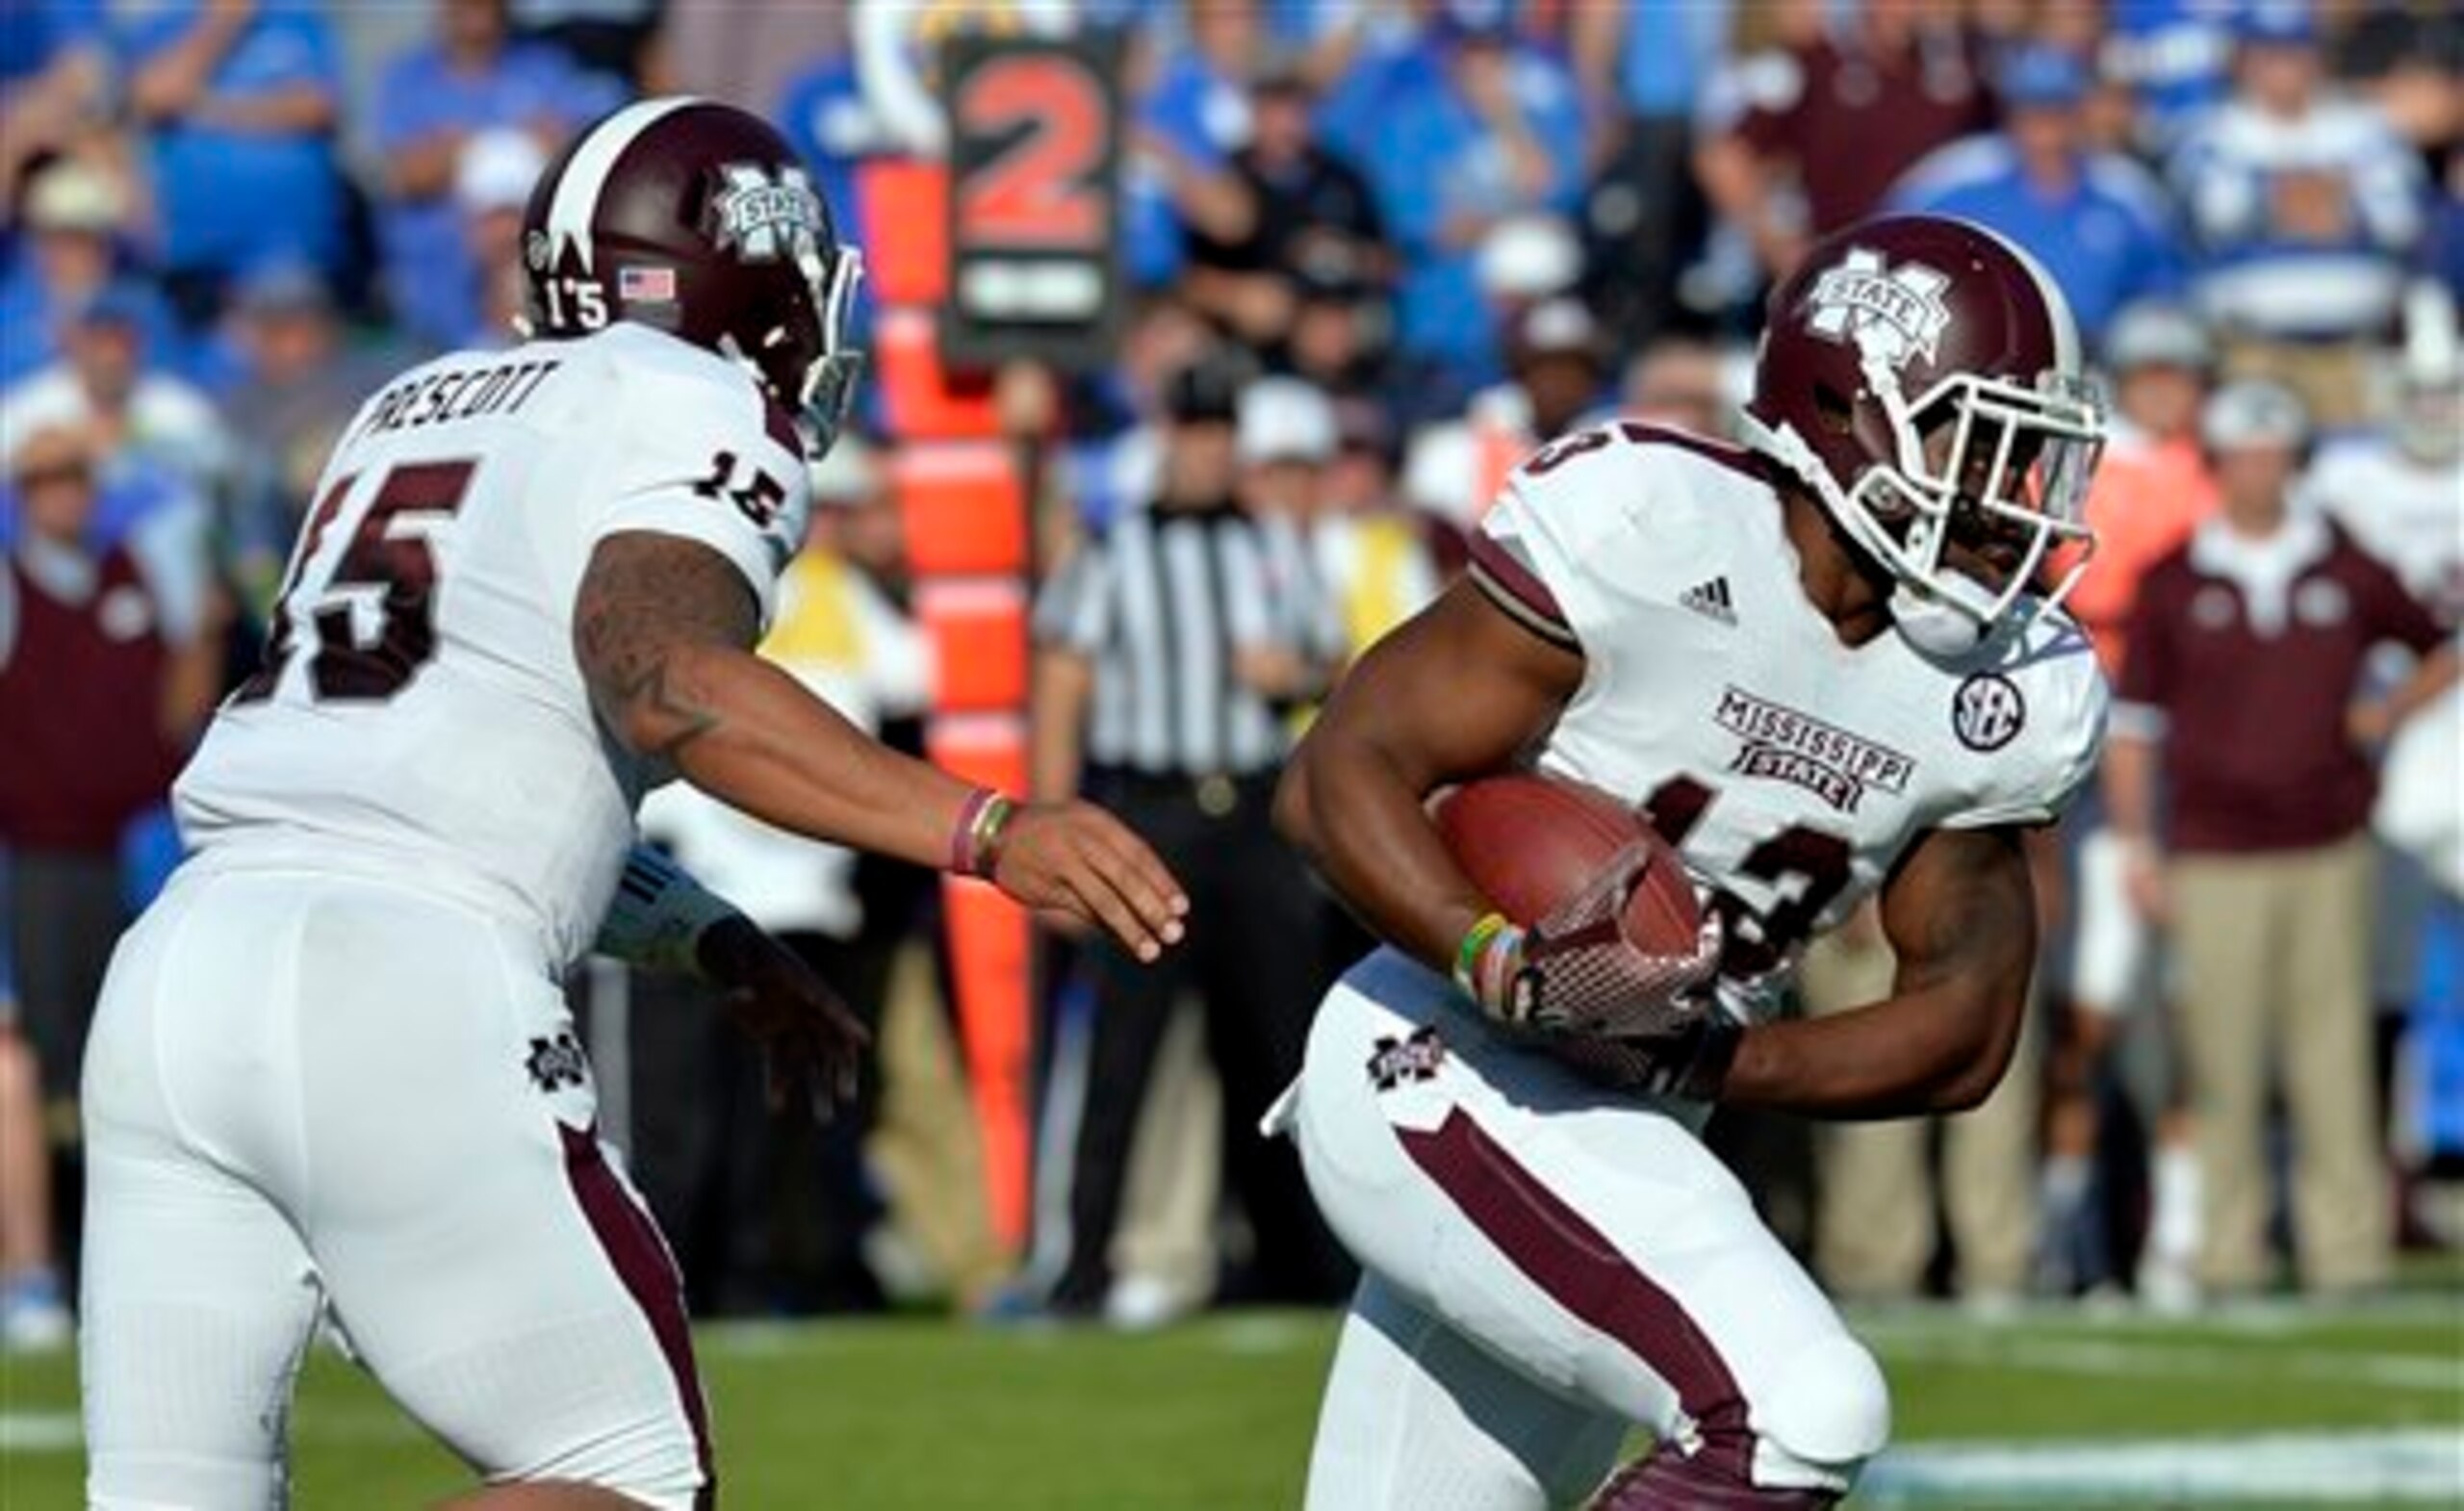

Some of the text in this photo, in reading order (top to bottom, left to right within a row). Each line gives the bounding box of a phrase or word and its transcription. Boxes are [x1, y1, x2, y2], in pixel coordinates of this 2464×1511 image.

[959, 56, 1107, 250] 2
[546, 277, 608, 328] 15
[1832, 277, 1916, 325] STATE
[360, 360, 561, 436] PRESCOTT
[223, 454, 483, 707] 15
[1717, 690, 1914, 789] MISSISSIPPI
[1746, 747, 1853, 810] STATE
